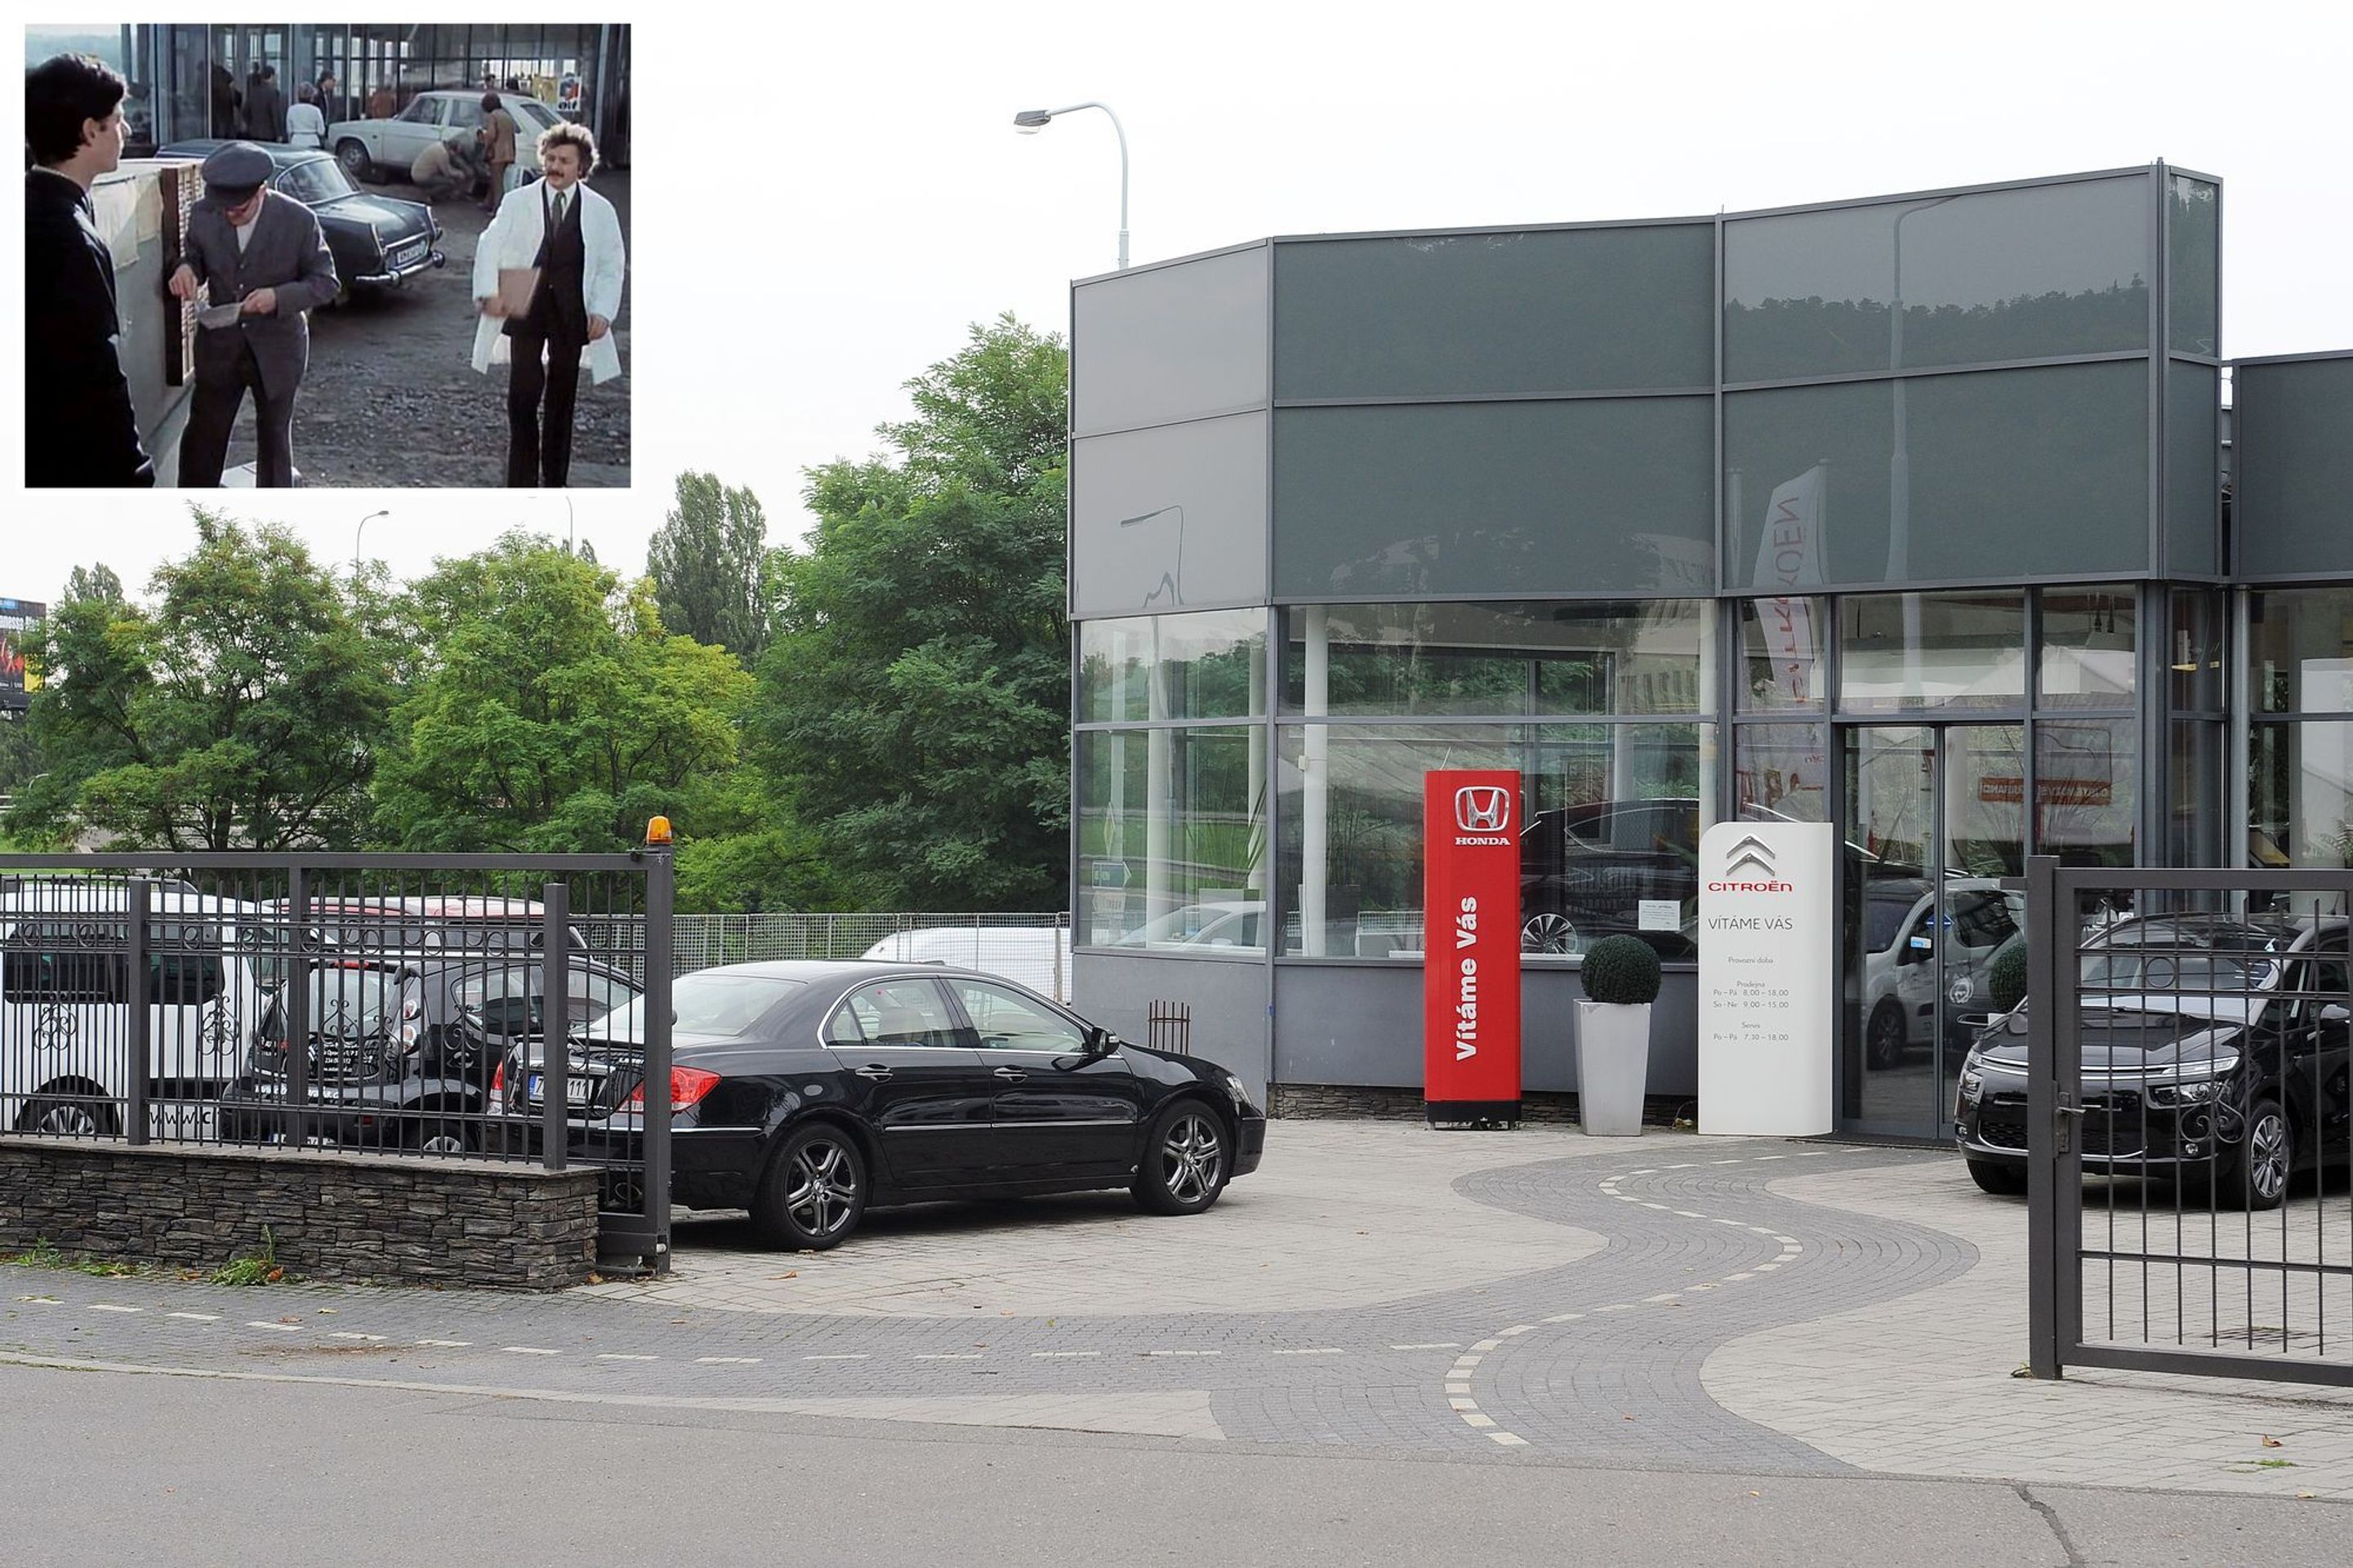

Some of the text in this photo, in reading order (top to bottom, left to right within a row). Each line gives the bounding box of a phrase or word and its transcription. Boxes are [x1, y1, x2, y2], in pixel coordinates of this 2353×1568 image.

[1455, 837, 1511, 846] HONDA
[1708, 880, 1793, 892] CITROËN
[1708, 915, 1794, 930] VÍTÁME VÁS
[1727, 956, 1774, 964] Provozní doba
[1455, 896, 1477, 1062] Vítáme Vás
[1736, 980, 1766, 989] Prodejna
[1741, 1021, 1761, 1029] Servis
